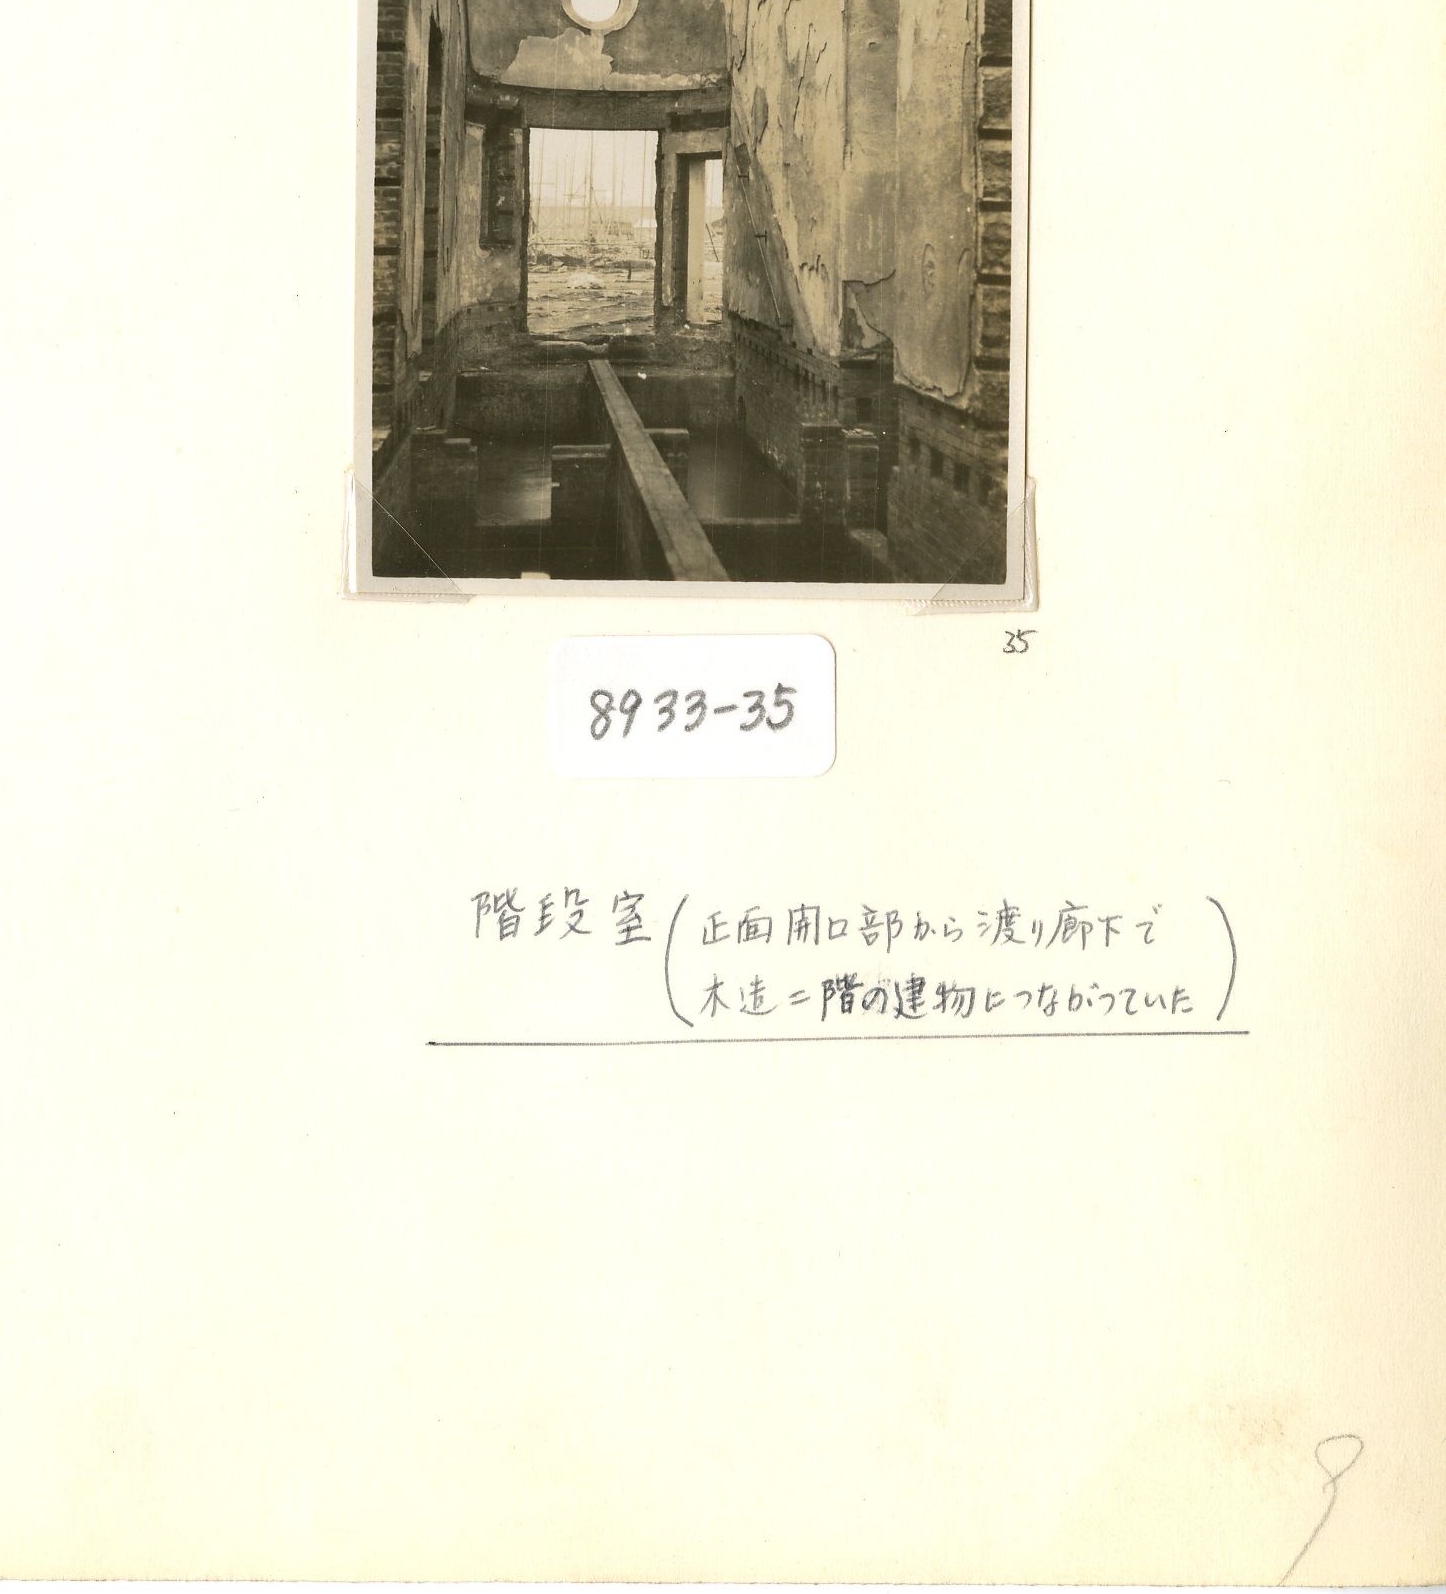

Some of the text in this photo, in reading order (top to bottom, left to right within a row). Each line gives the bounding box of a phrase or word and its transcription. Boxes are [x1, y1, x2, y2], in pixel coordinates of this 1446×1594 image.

[1002, 628, 1039, 655] 35
[588, 682, 798, 741] 8933-35
[470, 886, 653, 947] 階段室
